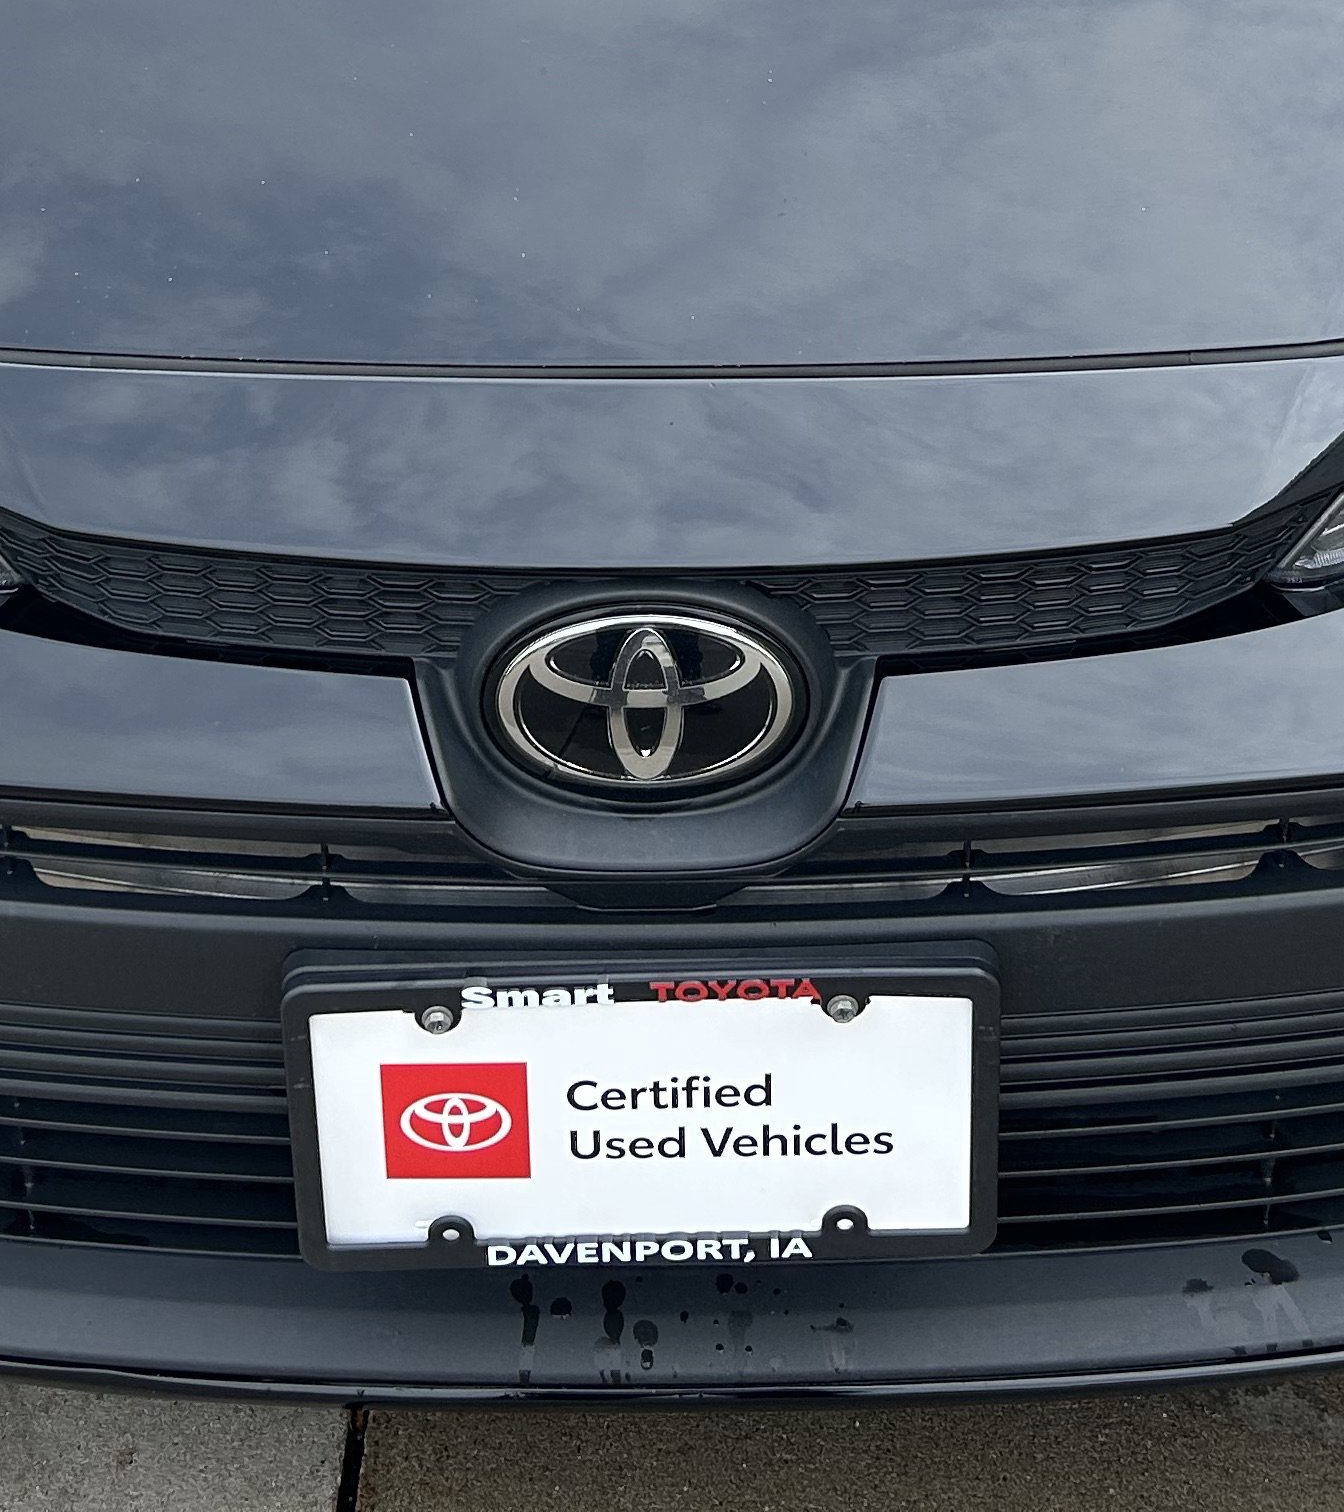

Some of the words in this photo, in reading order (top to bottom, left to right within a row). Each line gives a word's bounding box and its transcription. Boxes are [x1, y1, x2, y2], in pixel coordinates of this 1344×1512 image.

[461, 983, 615, 1009] Smart
[648, 978, 823, 1003] TOYOTA
[566, 1072, 773, 1111] Certified
[569, 1125, 687, 1160] Used
[700, 1122, 894, 1158] Vehicles
[487, 1238, 756, 1266] DAVENPORT,
[769, 1237, 813, 1259] IA
